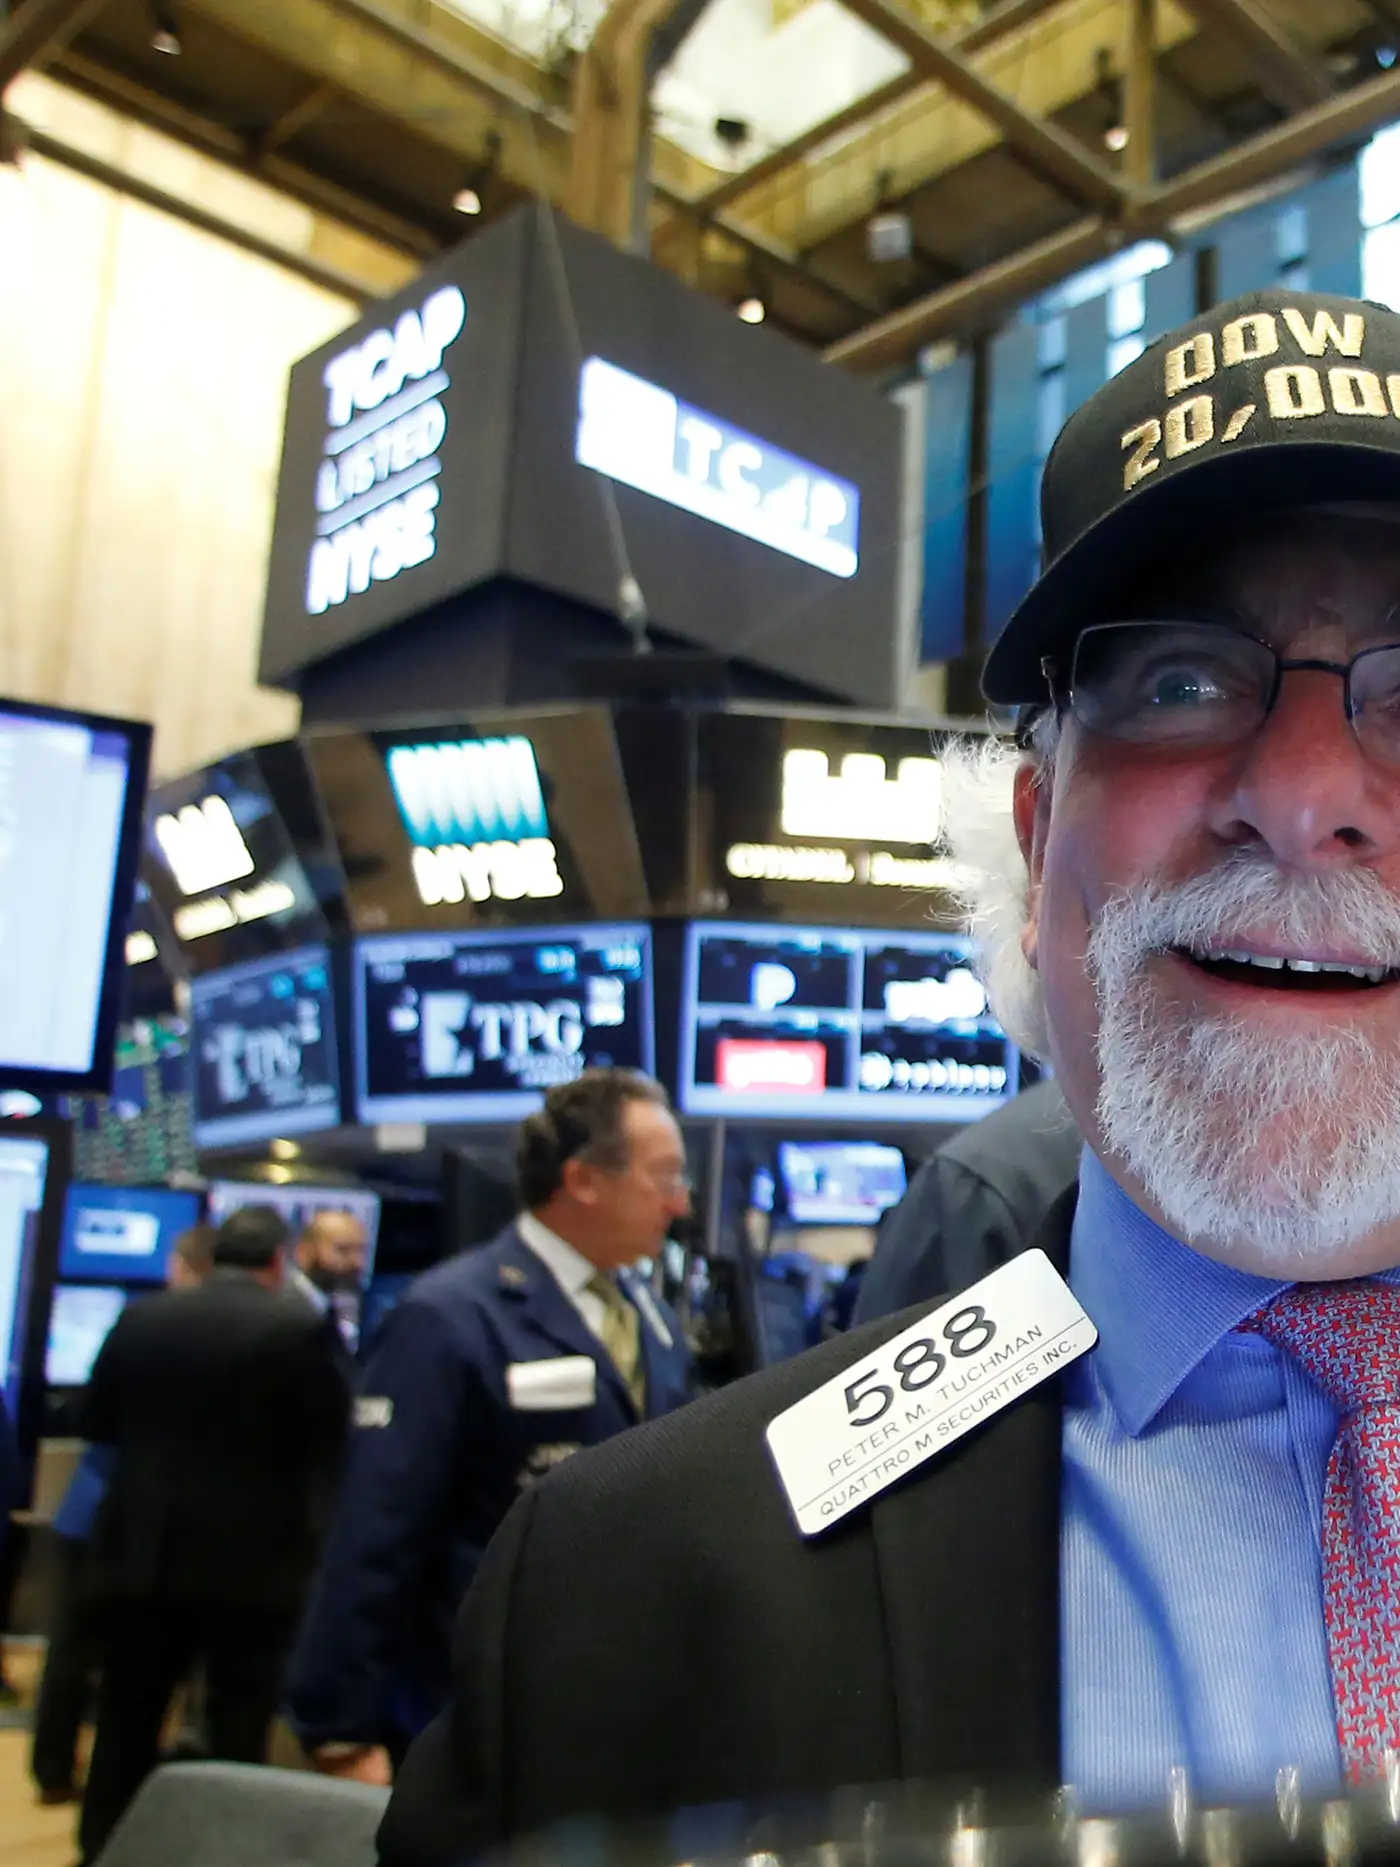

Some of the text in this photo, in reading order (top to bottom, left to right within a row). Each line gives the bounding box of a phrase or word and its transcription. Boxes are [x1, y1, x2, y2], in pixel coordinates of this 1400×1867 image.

[323, 285, 467, 427] TCAP
[1165, 309, 1365, 398] DOW
[317, 399, 447, 512] LISTED
[307, 480, 440, 614] NYSE
[411, 837, 564, 906] NYSE
[470, 998, 584, 1061] TPG
[828, 1325, 1043, 1476] PETER M. TUCHMAN
[844, 1305, 997, 1427] 588
[820, 1339, 1078, 1516] QUATTRO M SECURITIES INC.
